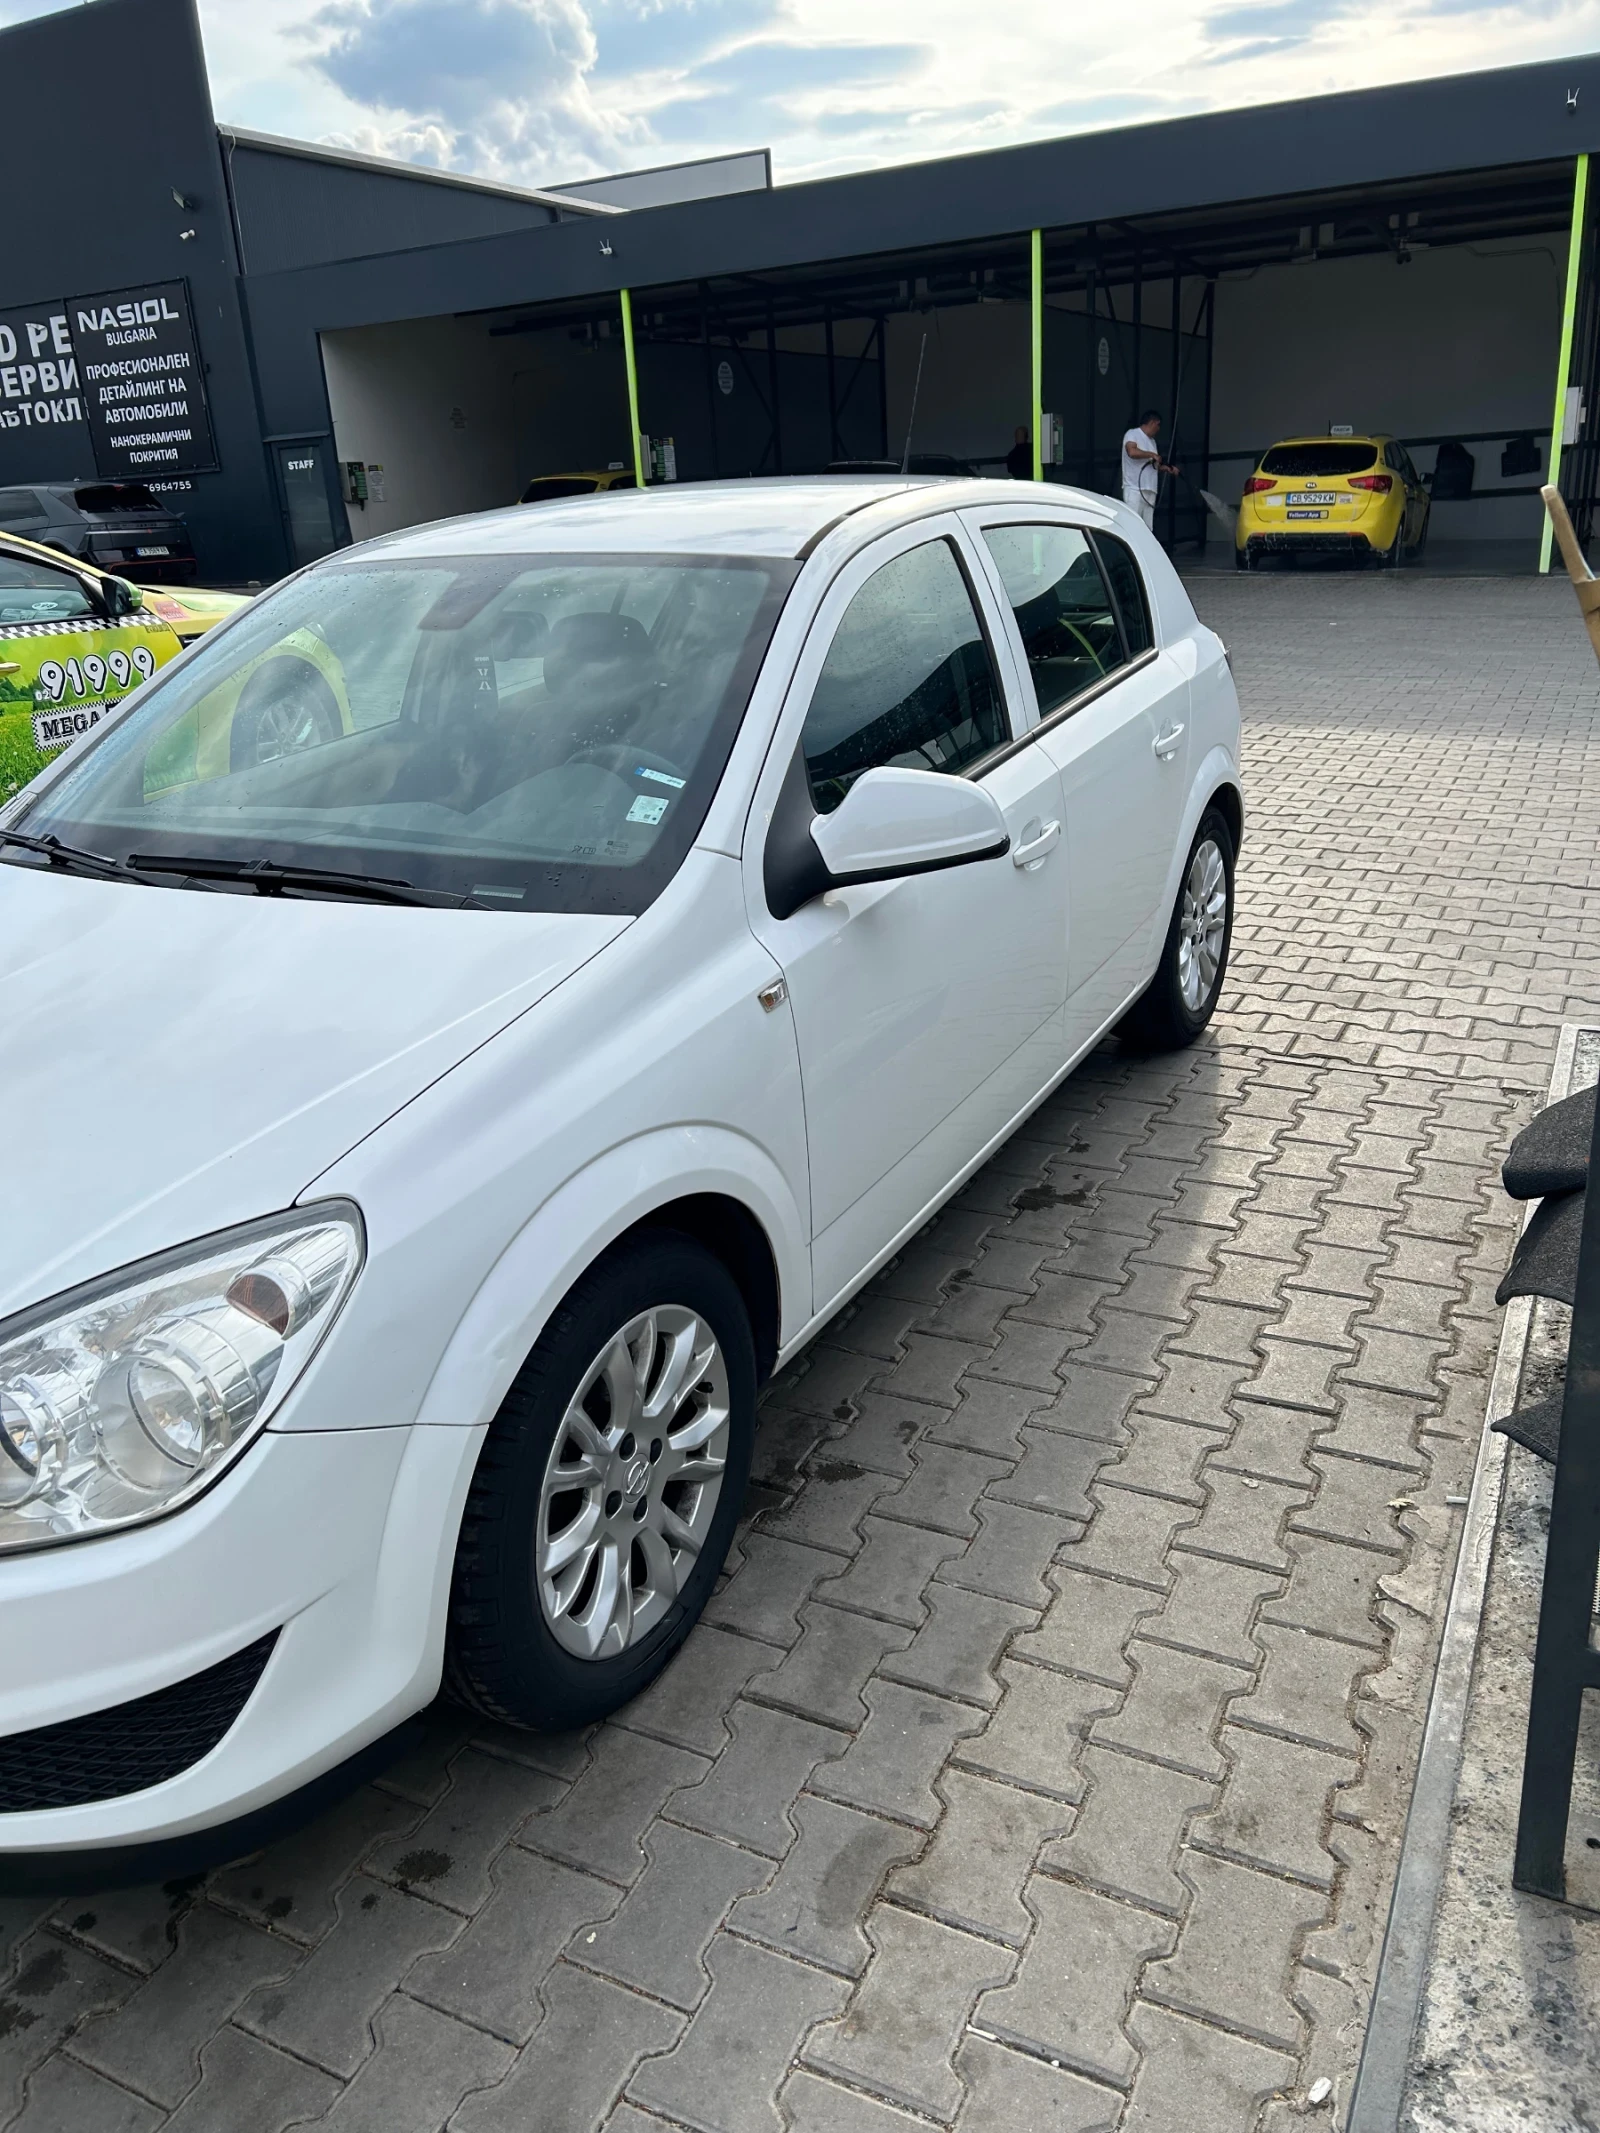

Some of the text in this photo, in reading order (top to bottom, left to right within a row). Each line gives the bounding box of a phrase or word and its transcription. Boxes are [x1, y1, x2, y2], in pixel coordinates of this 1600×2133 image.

[77, 298, 179, 332] NASIOL
[106, 327, 157, 346] BULGARIA
[86, 353, 190, 379] ПРОФЕСИОНАЛЕН
[99, 377, 187, 405] ДЕТАЙЛИНГ НА
[105, 401, 188, 423] АВТОМОБИЛИ
[110, 429, 192, 448] НАНОКЕРАМИЧНИ
[130, 448, 179, 464] ПОКРИТИЯ
[288, 459, 314, 471] STAFF
[39, 645, 156, 702] 91999
